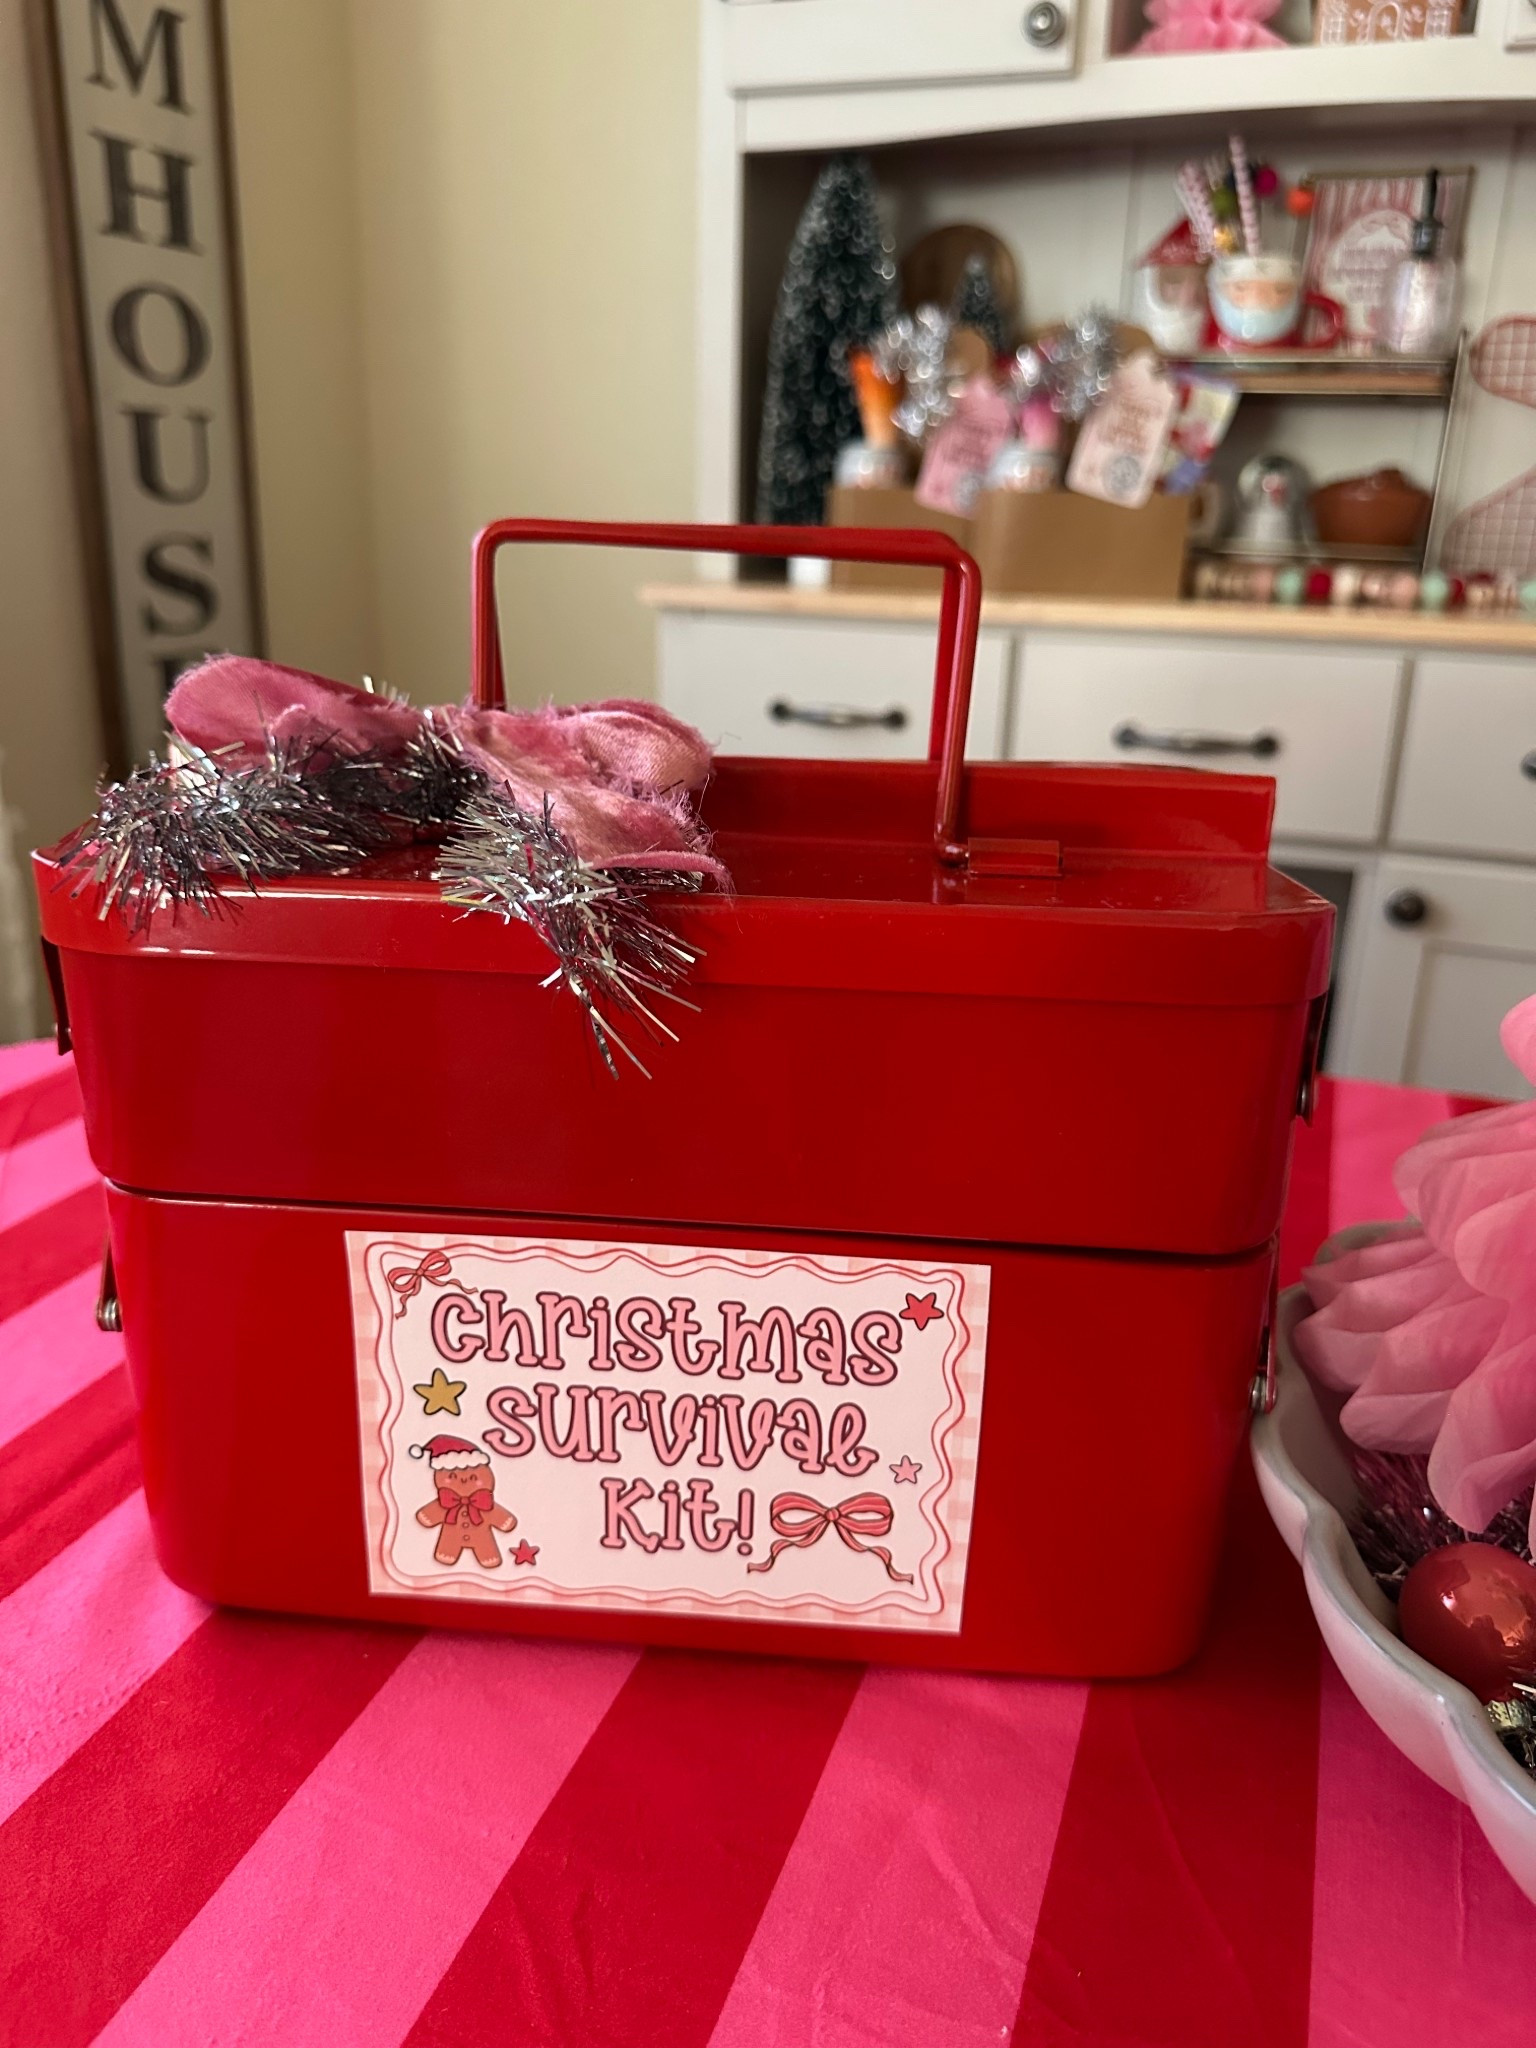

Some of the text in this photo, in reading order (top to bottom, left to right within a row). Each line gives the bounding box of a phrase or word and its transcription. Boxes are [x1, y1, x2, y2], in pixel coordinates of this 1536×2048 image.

[85, 0, 221, 700] MHOUS
[430, 1290, 903, 1386] Christmas
[600, 1477, 755, 1556] Kit!
